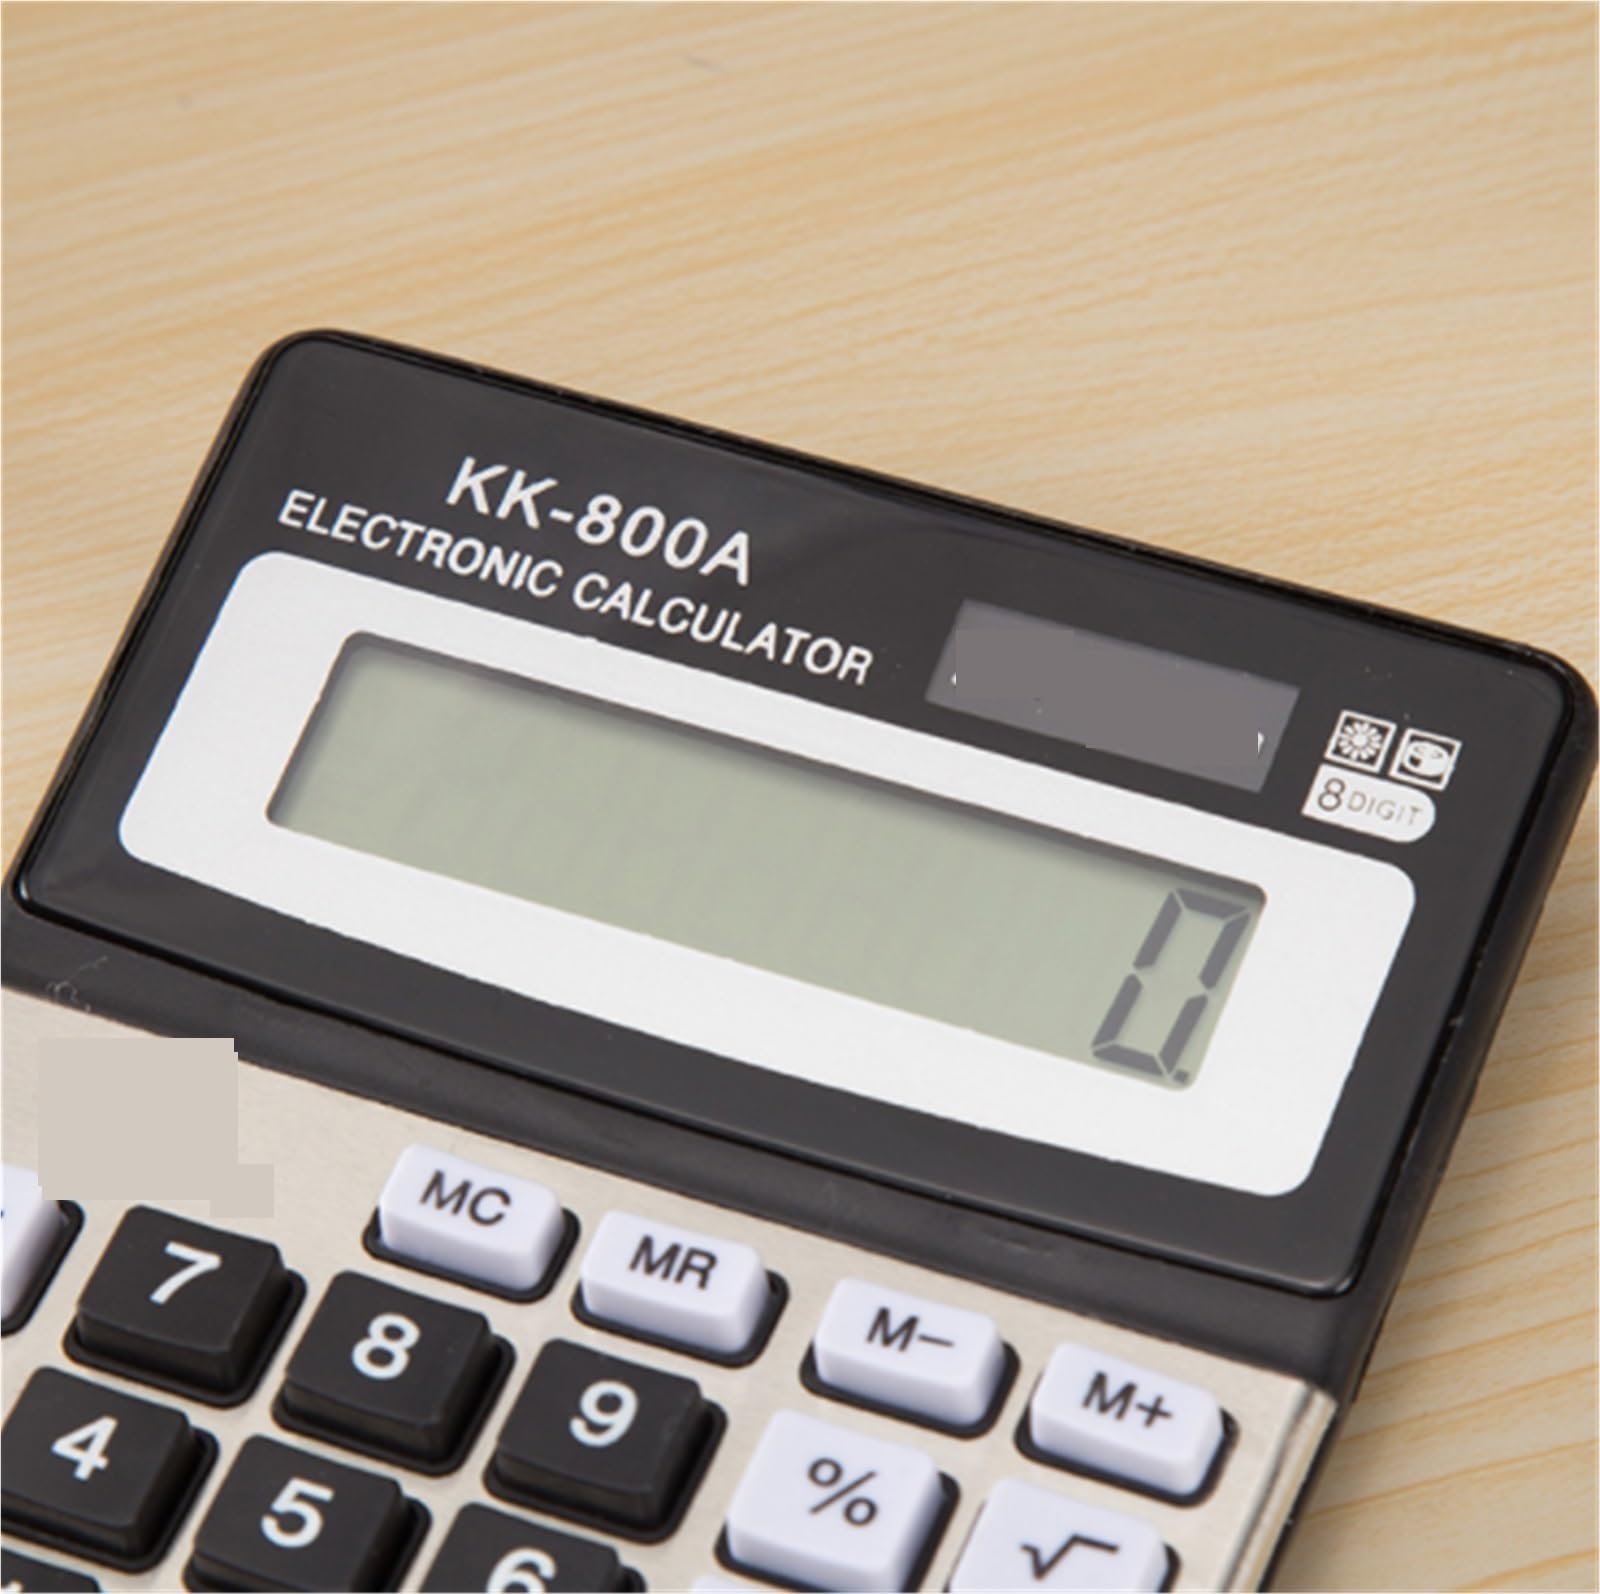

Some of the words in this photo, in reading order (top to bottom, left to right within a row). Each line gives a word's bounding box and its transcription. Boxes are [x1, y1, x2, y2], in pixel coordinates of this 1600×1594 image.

[445, 456, 751, 587] KK-800A
[278, 488, 565, 599] ELECTRONIC
[572, 571, 874, 685] CALCULATOR
[419, 1170, 512, 1226] MC
[149, 1241, 222, 1305] 7
[628, 1235, 718, 1290] MR
[351, 1313, 420, 1379] 8
[569, 1380, 639, 1447] 9
[1081, 1371, 1172, 1428] M+
[51, 1415, 118, 1480] 4
[260, 1477, 334, 1548] 5
[807, 1457, 878, 1527] %
[486, 1547, 557, 1593] 6
